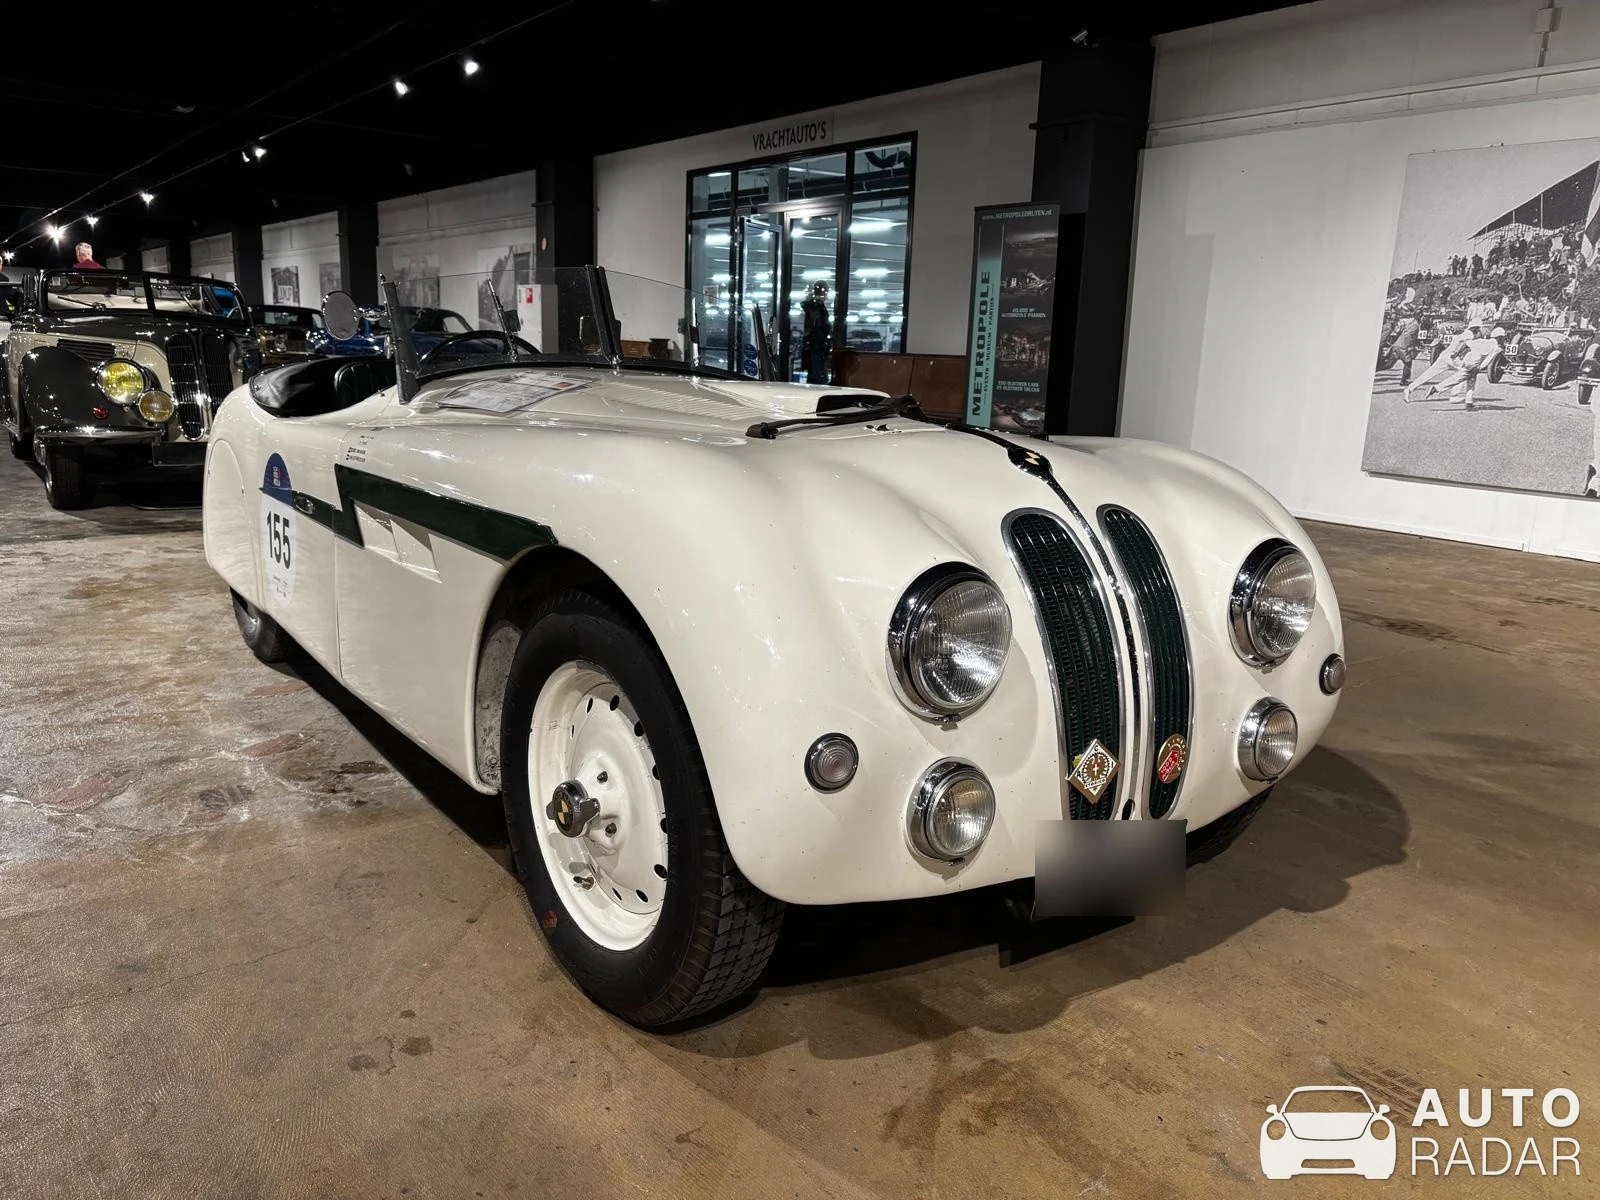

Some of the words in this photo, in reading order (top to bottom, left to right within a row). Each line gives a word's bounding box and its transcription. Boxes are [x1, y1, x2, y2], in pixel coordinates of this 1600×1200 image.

[753, 121, 827, 152] VRACHTAUTO'S
[971, 271, 991, 416] METROPOLE
[1505, 345, 1517, 354] 50
[267, 511, 291, 569] 155
